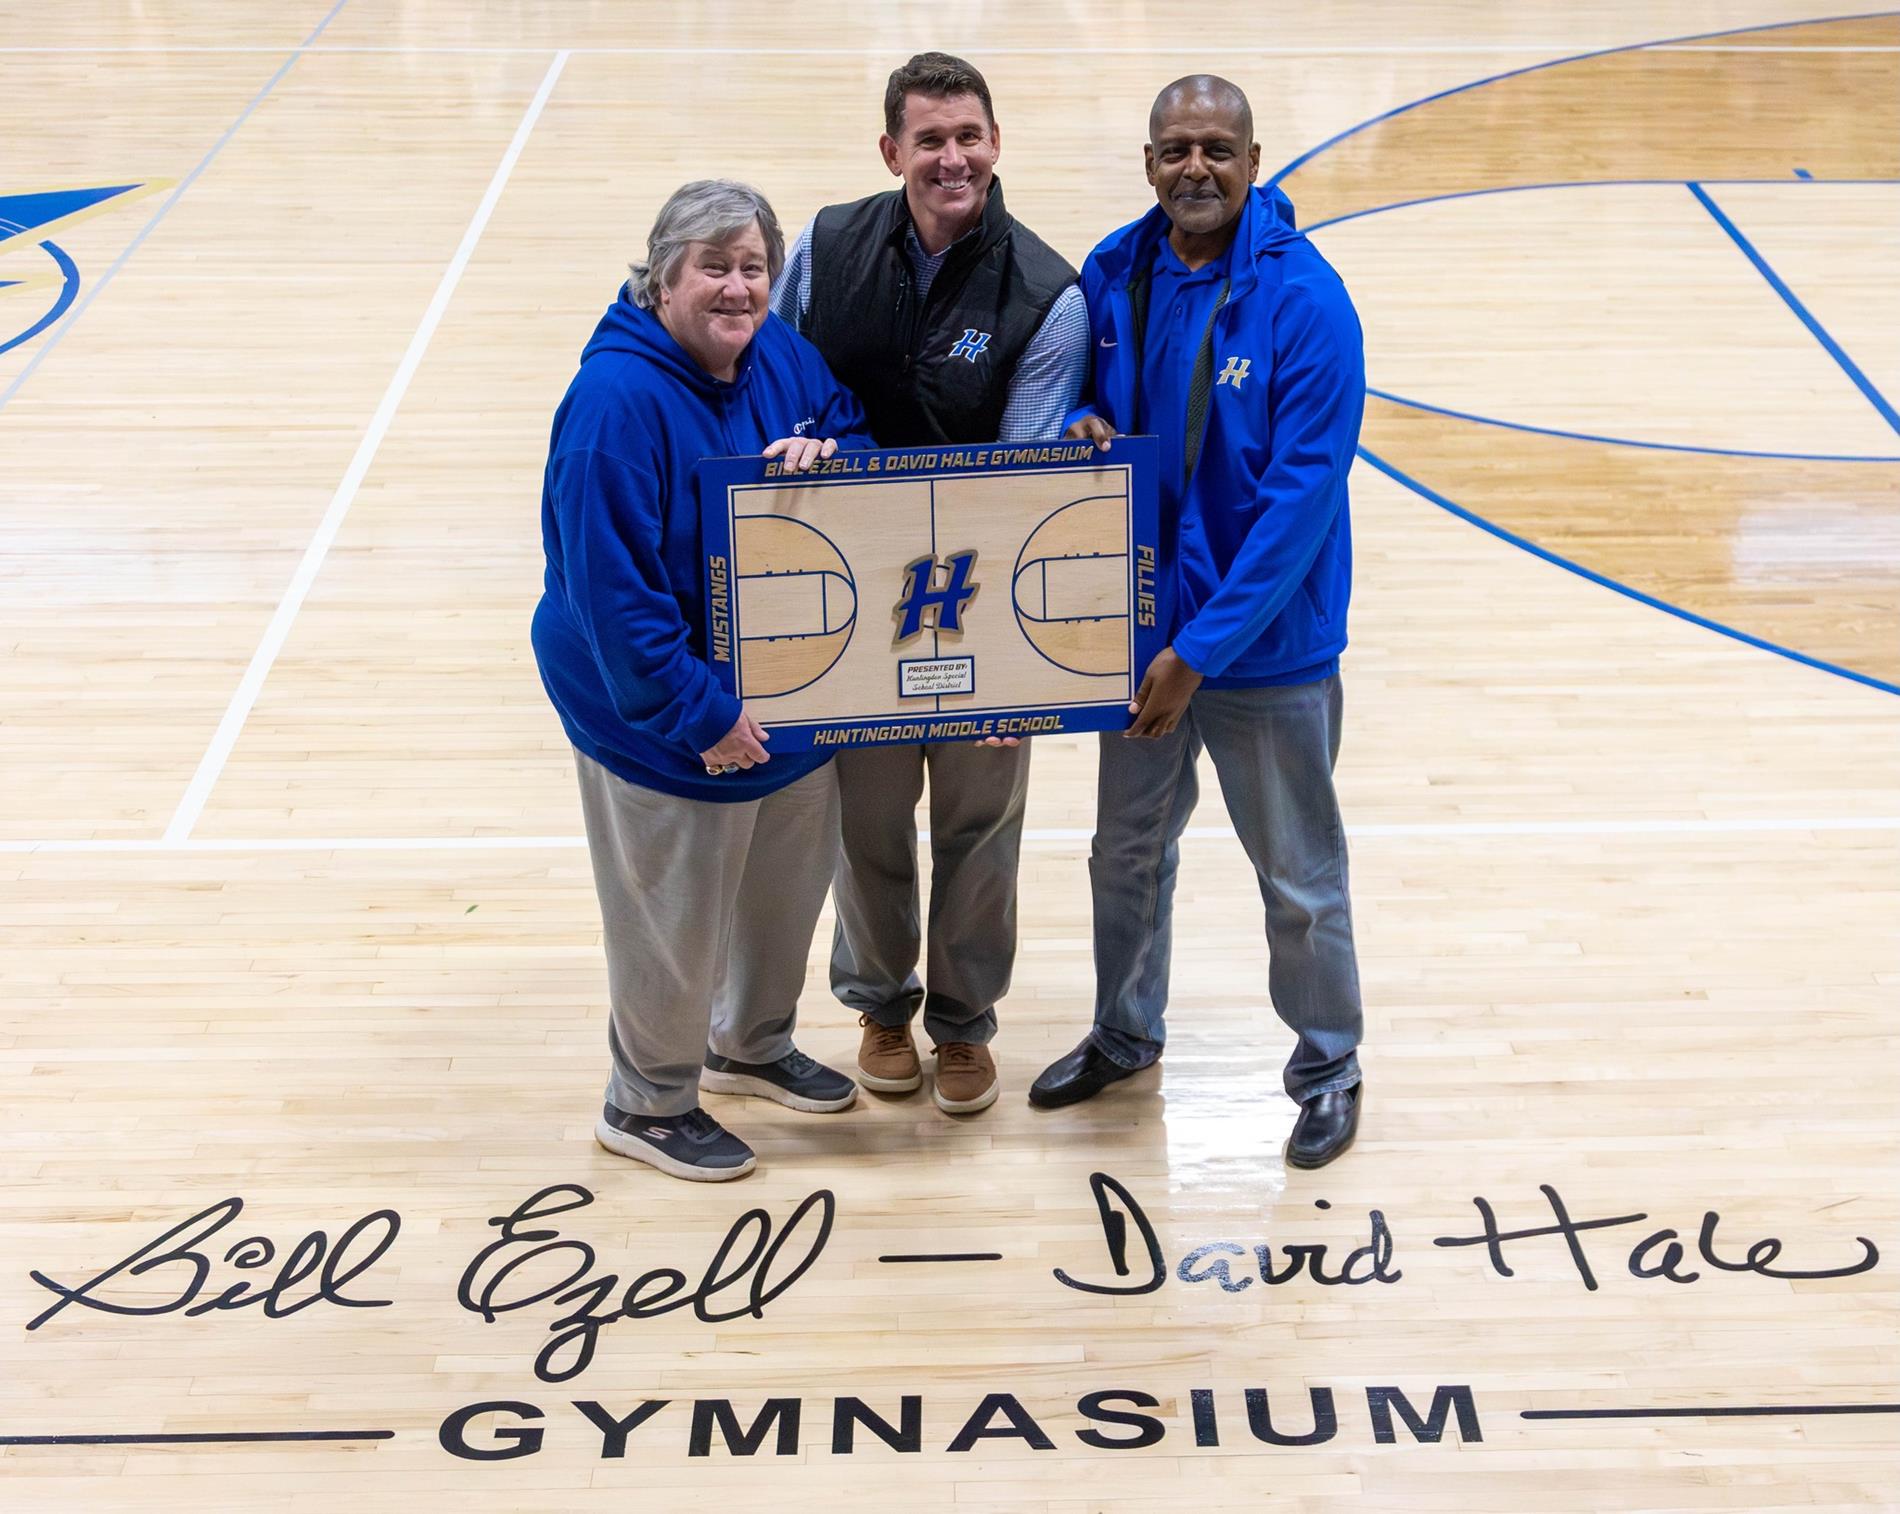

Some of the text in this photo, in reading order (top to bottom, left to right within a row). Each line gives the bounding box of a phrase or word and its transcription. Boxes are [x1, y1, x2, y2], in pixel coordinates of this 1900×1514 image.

[949, 329, 992, 363] H
[1216, 357, 1251, 389] H
[867, 457, 880, 471] &
[885, 454, 938, 471] DAVID
[940, 451, 988, 468] HALE
[990, 445, 1094, 465] GYMNASIUM
[891, 549, 980, 646] H
[1137, 544, 1155, 626] FILLIES
[710, 555, 730, 662] MUSTANGS
[907, 664, 954, 673] PRESENTED
[942, 671, 967, 681] Special
[912, 683, 935, 691] School
[813, 715, 1064, 745] HUNTINGDON MIDDLE SCHOOL
[26, 1197, 401, 1330] Bill
[457, 1184, 836, 1383] Ezell
[1053, 1172, 1402, 1295] David
[1433, 1184, 1879, 1291] Hale
[438, 1385, 1483, 1461] GYMNASIUM
